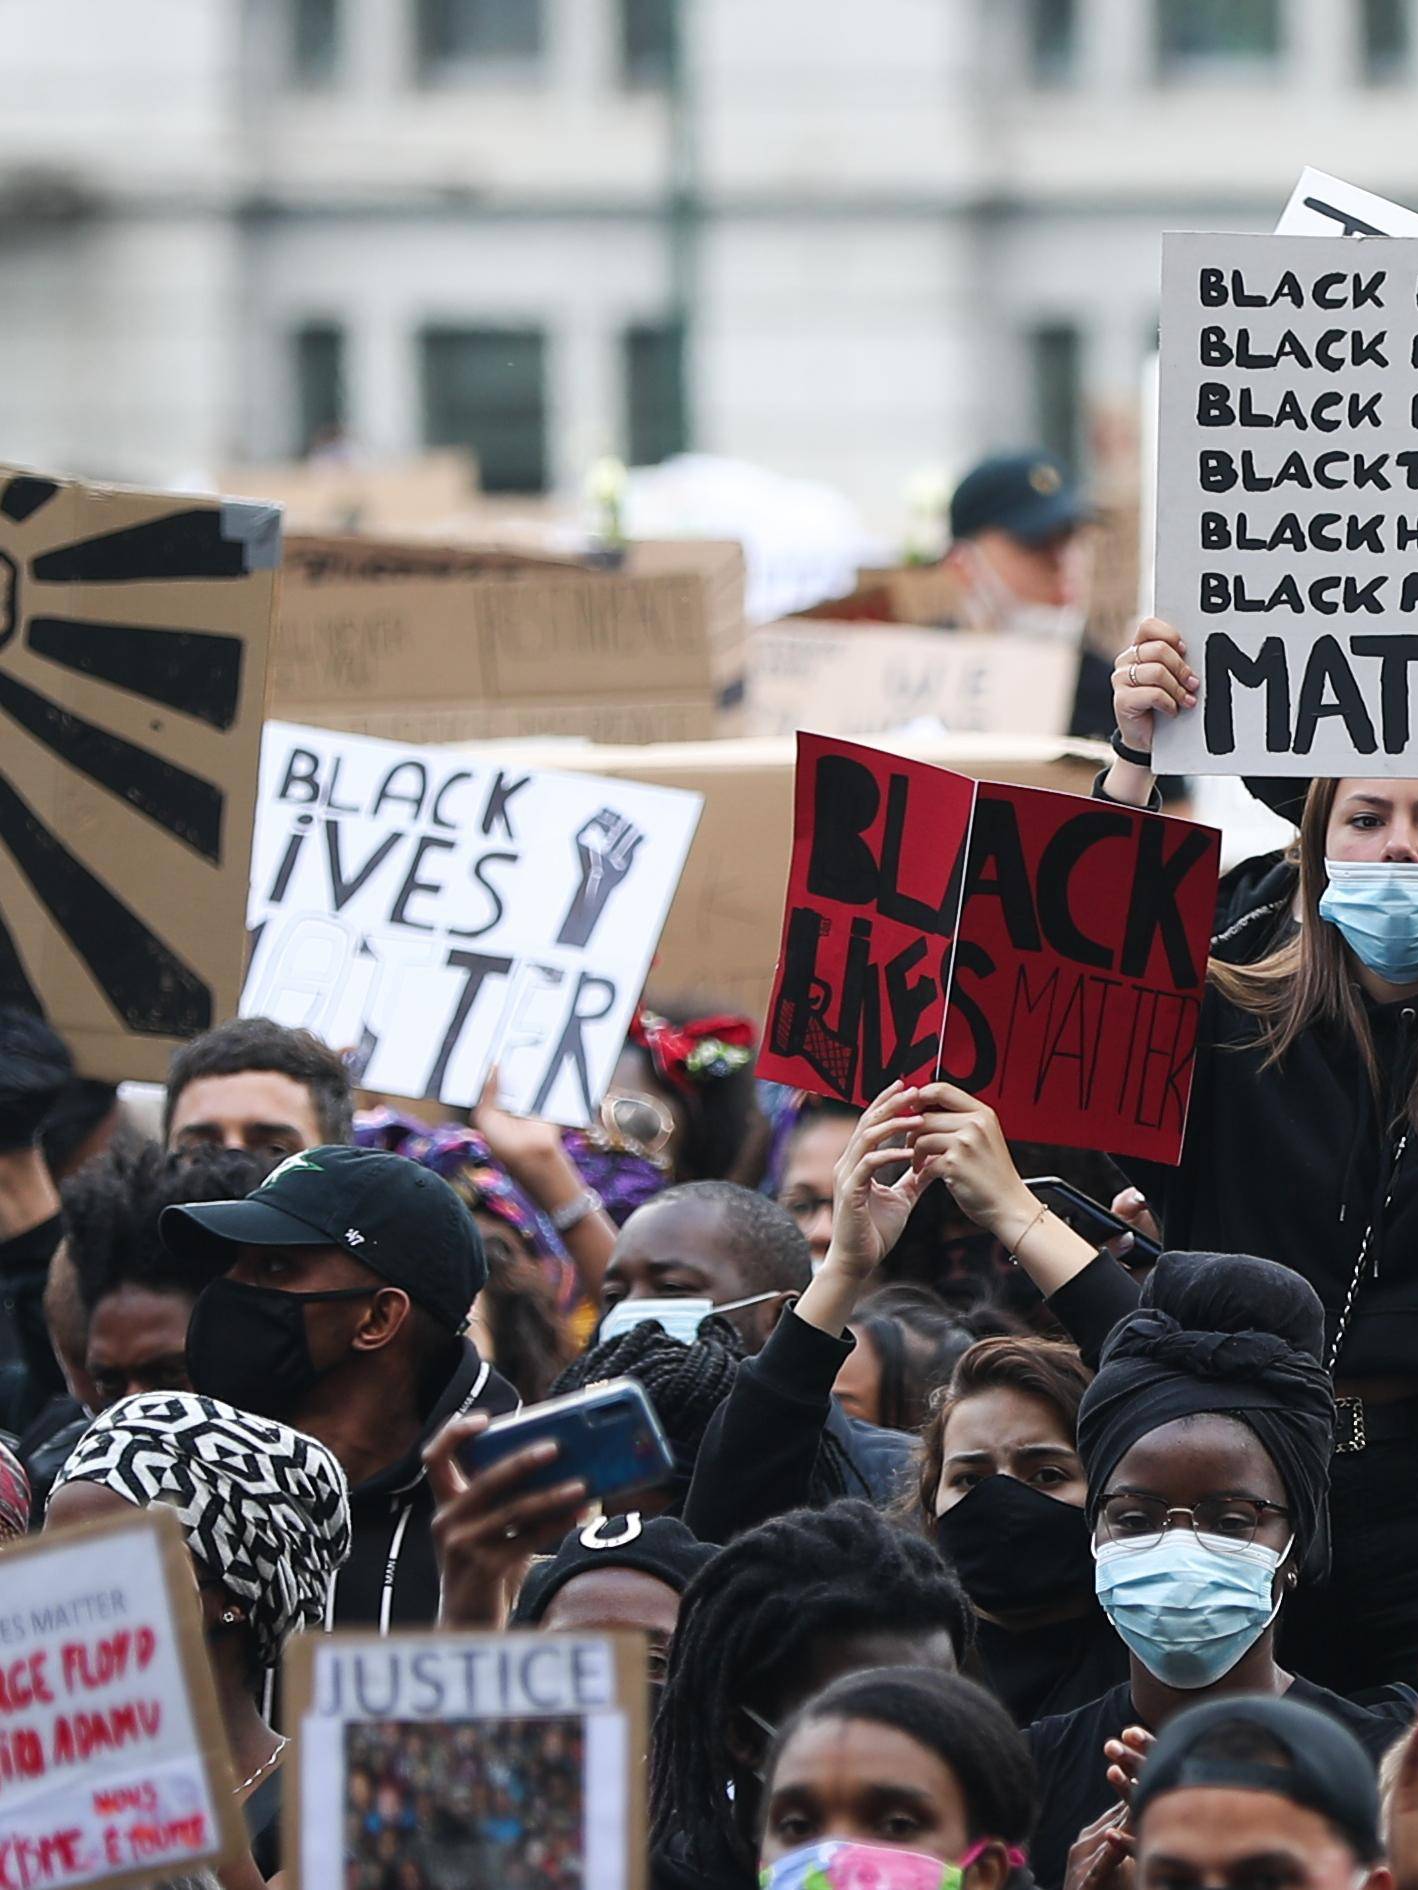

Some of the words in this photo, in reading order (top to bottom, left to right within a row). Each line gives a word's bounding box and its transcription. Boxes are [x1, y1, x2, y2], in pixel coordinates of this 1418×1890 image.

[1199, 267, 1388, 309] BLACK
[1199, 325, 1391, 373] BLACK
[1196, 382, 1384, 432] BLACK
[1199, 511, 1387, 554] BLACK
[1199, 571, 1390, 615] BLACK
[278, 747, 532, 840] BLACK
[806, 754, 1214, 990] BLACK
[240, 914, 617, 1127] ATTER
[998, 962, 1201, 1134] MATTER
[29, 1588, 129, 1635] MATTER
[60, 1624, 158, 1695] FLOYD
[318, 1644, 610, 1717] JUSTICE
